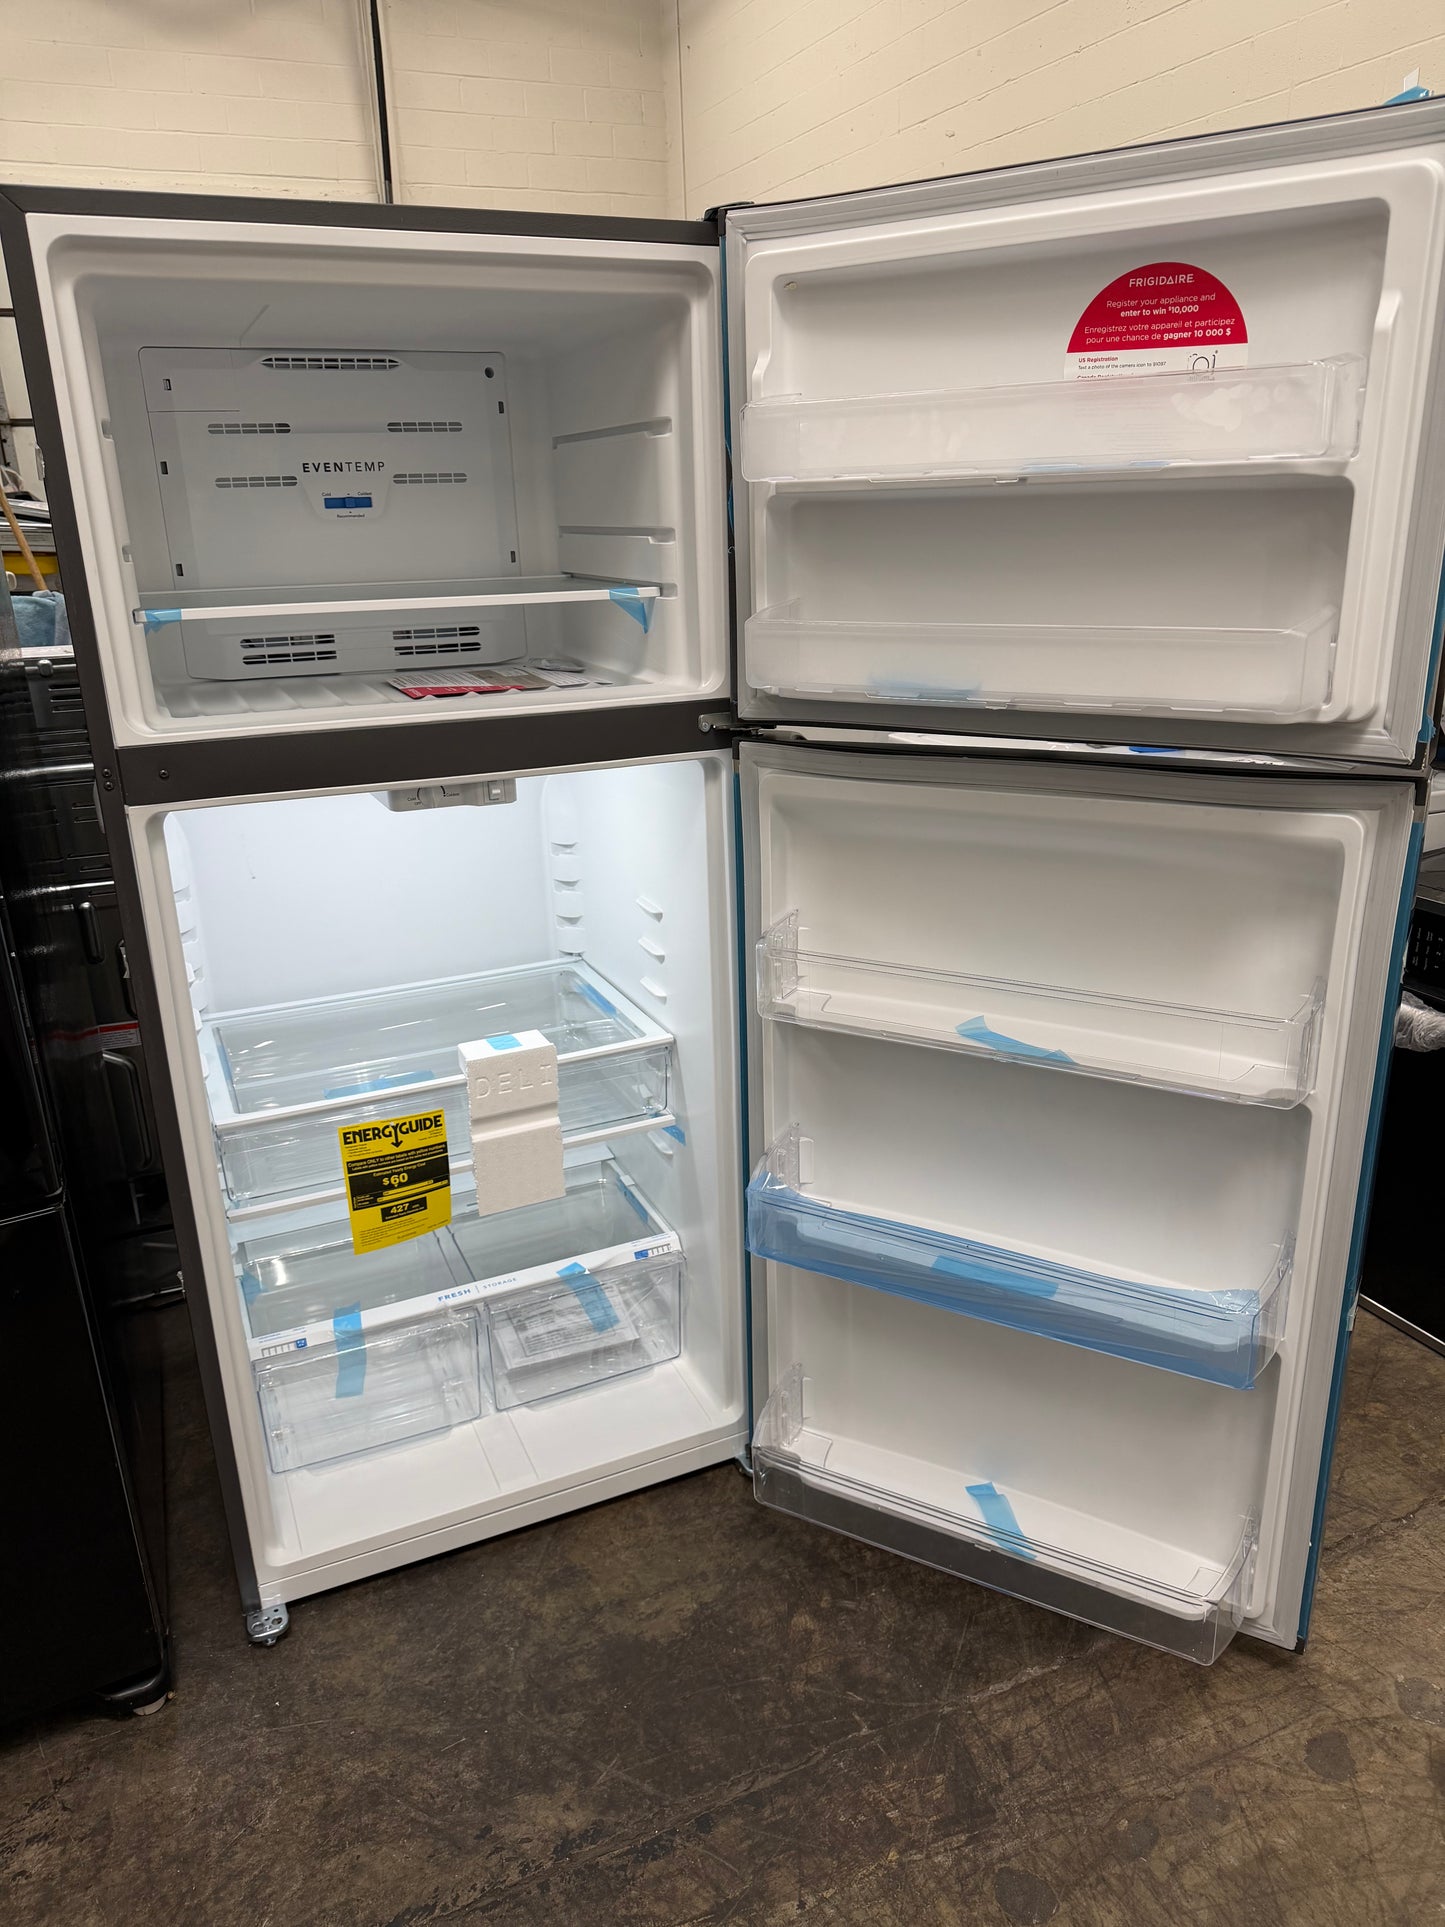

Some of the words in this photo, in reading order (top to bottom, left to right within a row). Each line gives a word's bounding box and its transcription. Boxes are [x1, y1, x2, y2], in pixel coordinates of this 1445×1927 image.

[1129, 274, 1194, 288] FRIGIDAIRE
[1106, 300, 1138, 308] Register
[1140, 298, 1158, 308] your
[1160, 295, 1198, 305] appliance
[1200, 293, 1216, 301] and
[1120, 309, 1140, 318] enter
[1168, 305, 1199, 315] $10,000
[1084, 325, 1127, 334] Enregistrez
[1151, 322, 1182, 331] appareil
[1194, 318, 1235, 328] participez
[1086, 337, 1103, 345] pour
[1122, 334, 1150, 342] chance
[1164, 332, 1192, 341] gagner
[1206, 328, 1224, 337] 000
[1226, 328, 1232, 336] $
[302, 461, 385, 473] EVENTEMP
[476, 1064, 553, 1099] DELI
[342, 1114, 442, 1147] ENERGYGUIDE
[382, 1173, 408, 1185] $60
[391, 1203, 409, 1214] 427
[438, 1288, 471, 1302] FRESH
[483, 1277, 517, 1289] STORAGE
